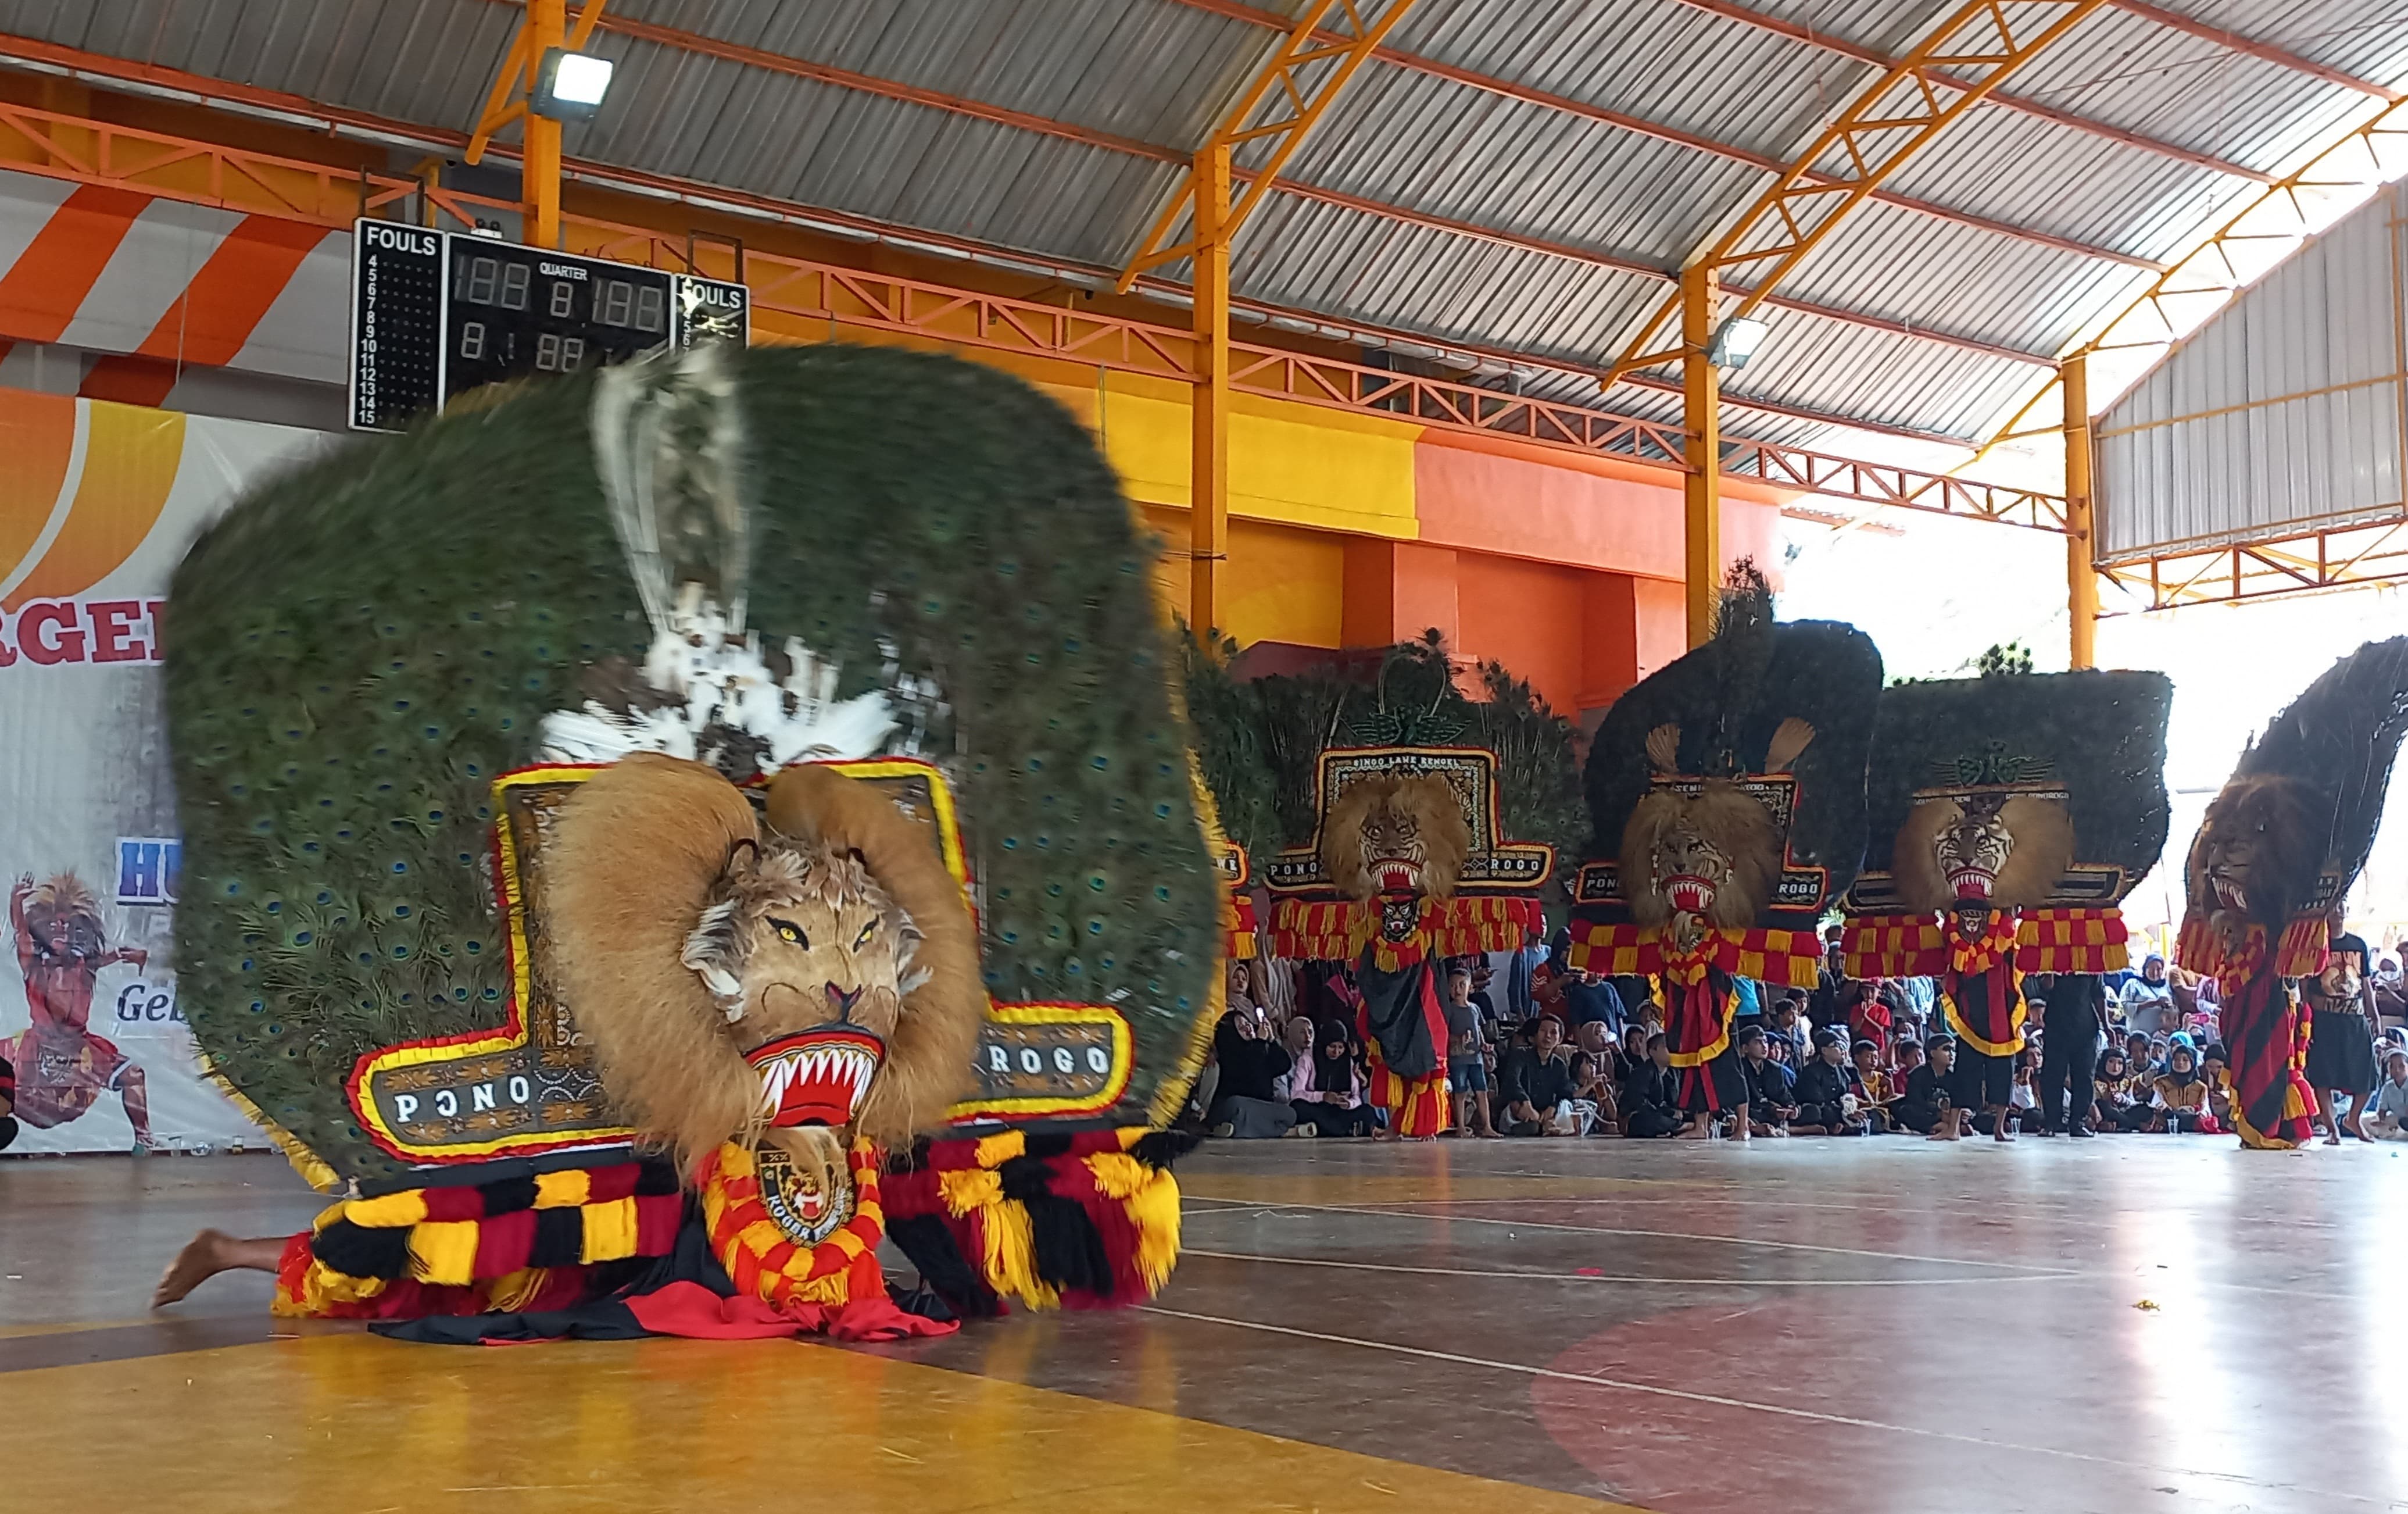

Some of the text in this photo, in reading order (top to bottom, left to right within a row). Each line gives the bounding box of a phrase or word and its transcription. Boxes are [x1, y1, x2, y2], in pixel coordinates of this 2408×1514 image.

[367, 226, 436, 256] FOULS
[368, 254, 377, 267] 4
[368, 269, 377, 281] 5
[539, 262, 588, 281] QUARTER
[367, 283, 376, 295] 6
[367, 297, 376, 309] 7
[367, 310, 375, 324] 8
[366, 325, 375, 338] 9
[684, 320, 691, 333] 5
[361, 338, 377, 352] 10
[683, 334, 691, 345] 6
[361, 352, 375, 366] 11
[360, 367, 377, 381] 12
[359, 381, 376, 395] 13
[359, 395, 376, 409] 14
[359, 410, 375, 424] 15
[1270, 859, 1539, 876] PONO ROGO
[1586, 879, 1619, 888] PON
[988, 1045, 1109, 1074] ROGO
